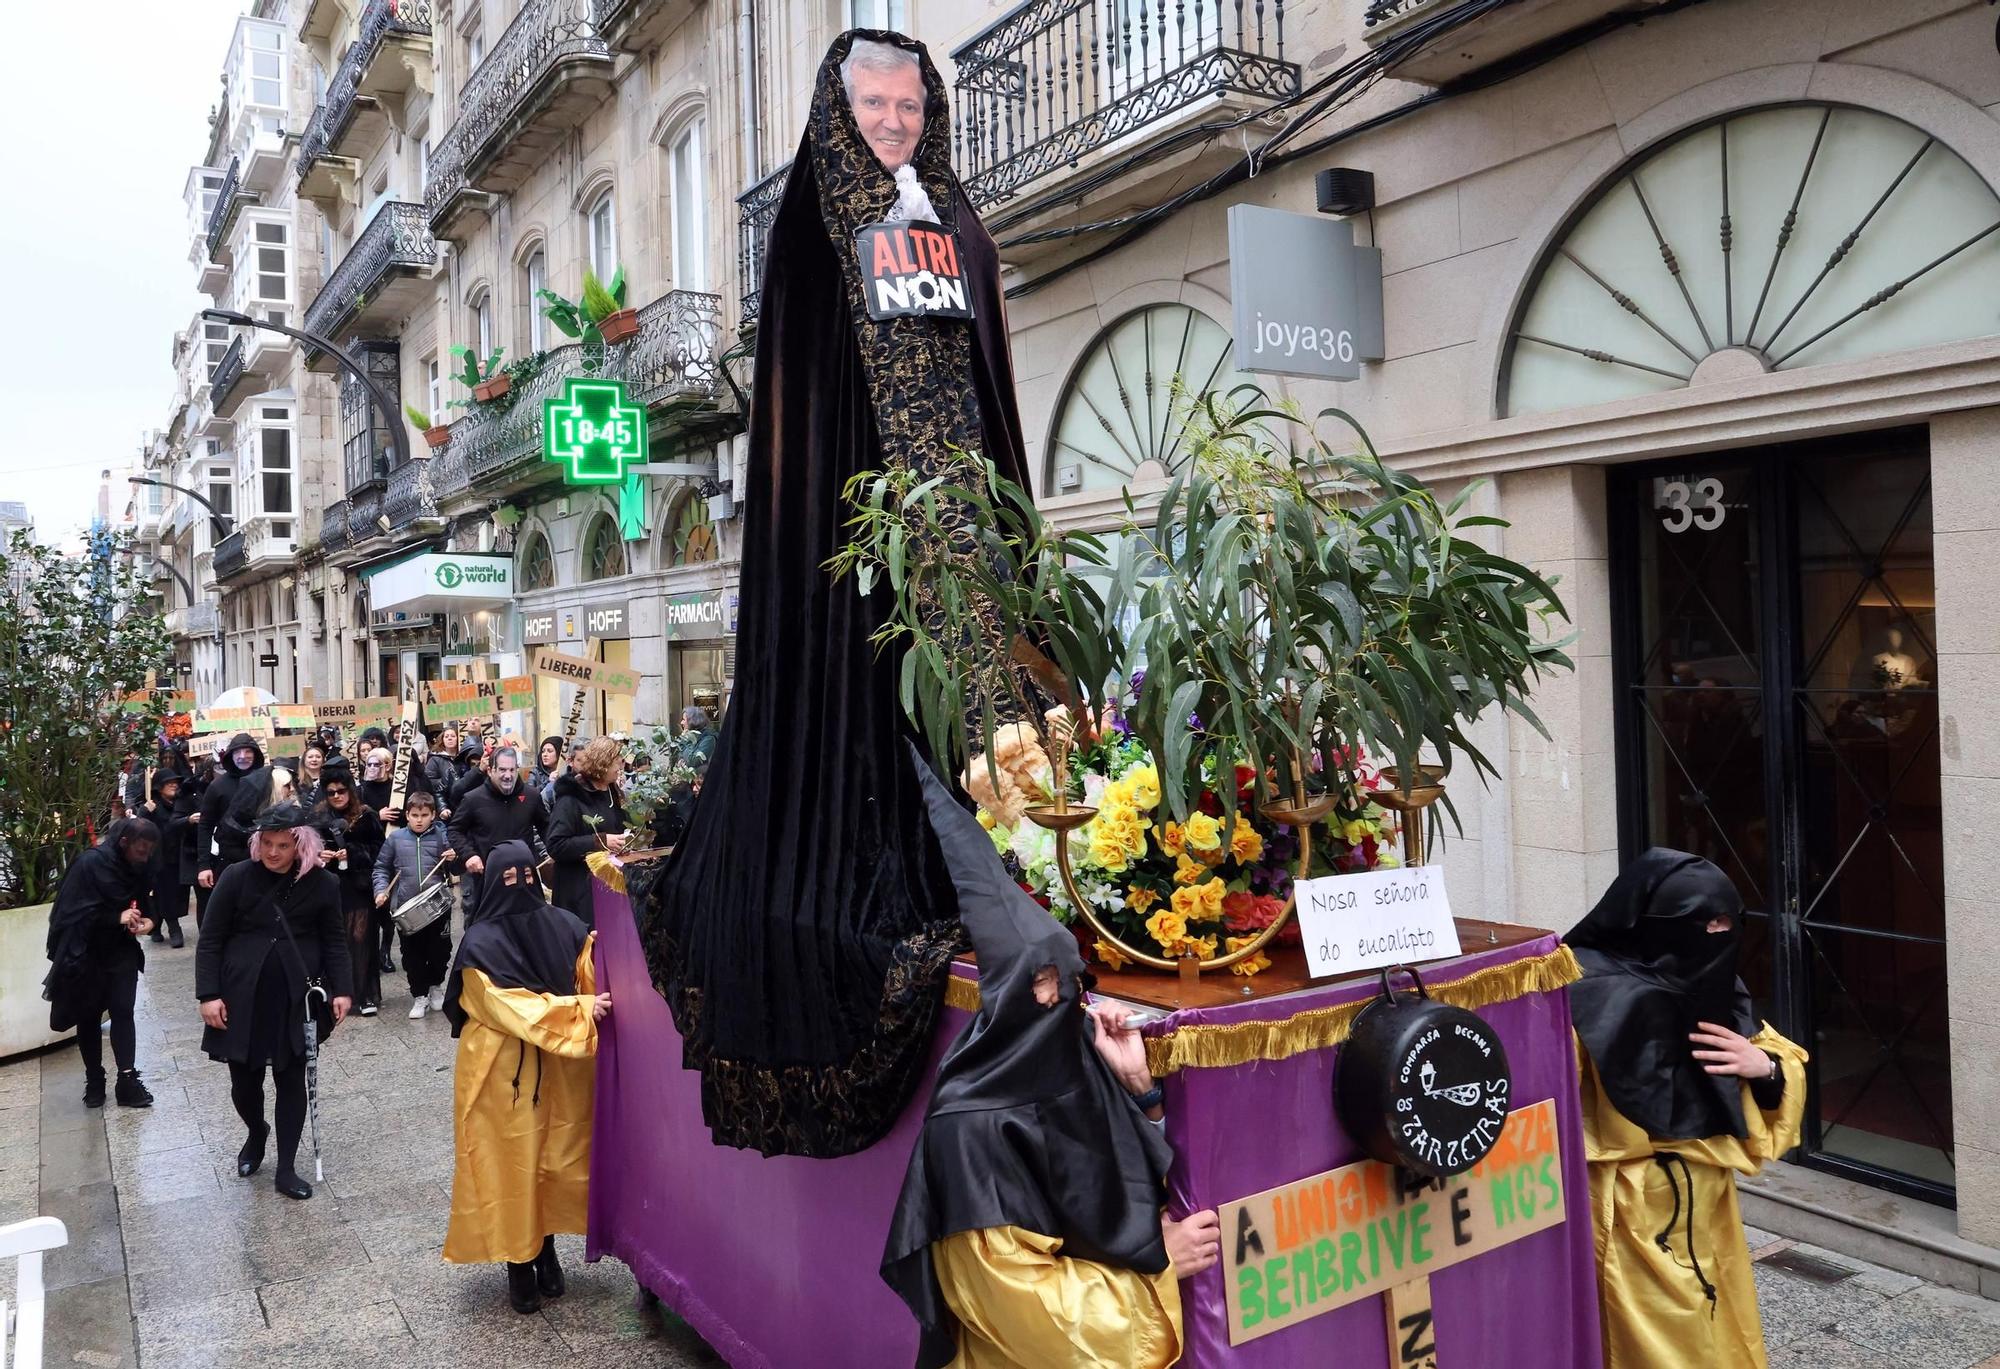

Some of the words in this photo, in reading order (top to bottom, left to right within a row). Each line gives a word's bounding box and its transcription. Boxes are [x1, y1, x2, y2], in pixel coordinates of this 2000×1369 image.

[873, 229, 960, 277] ALTRI
[875, 270, 967, 312] NON
[1254, 311, 1353, 362] joya36
[562, 419, 631, 446] 18:45
[1662, 477, 1726, 533] 33
[464, 564, 494, 573] natural
[465, 568, 506, 583] world
[588, 609, 623, 632] HOFF
[668, 602, 722, 625] FARMACIA
[525, 617, 552, 637] HOFF
[540, 657, 592, 681] LIBERAR
[427, 693, 437, 705] A
[478, 682, 496, 698] FAI
[496, 696, 505, 711] E
[195, 709, 206, 720] A
[251, 706, 271, 717] FAI
[393, 760, 409, 795] NON
[1311, 891, 1358, 912] Nosa
[1374, 882, 1429, 906] señora
[1319, 937, 1341, 962] do
[1400, 1029, 1441, 1084] COMPARSA
[1455, 1024, 1492, 1058] DECANA
[1396, 1097, 1413, 1112] OS
[1236, 1206, 1265, 1266] A
[1272, 1162, 1388, 1252] UNION
[1238, 1202, 1435, 1330] BEMBRIVE
[1452, 1187, 1473, 1248] E
